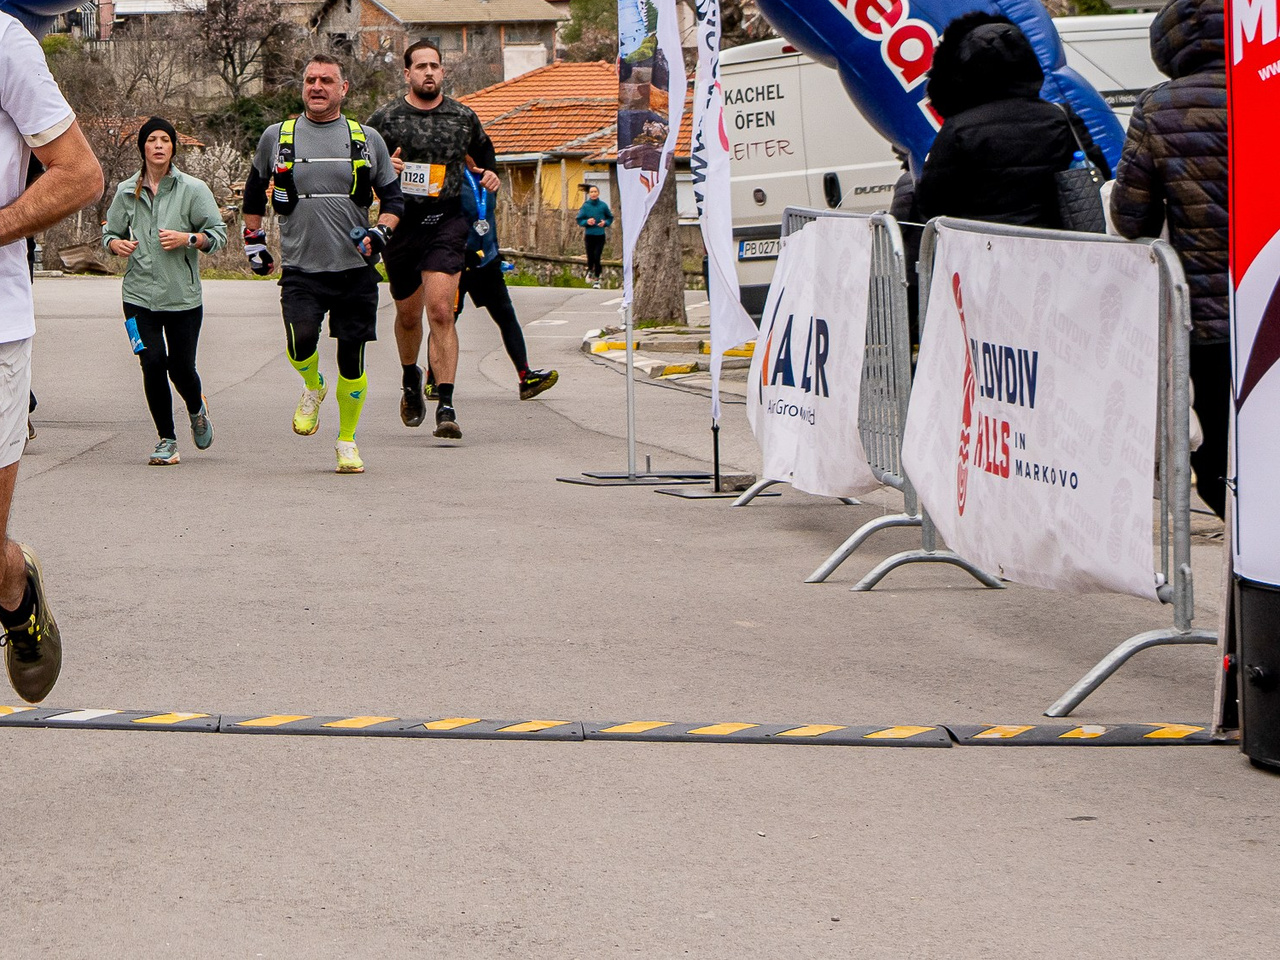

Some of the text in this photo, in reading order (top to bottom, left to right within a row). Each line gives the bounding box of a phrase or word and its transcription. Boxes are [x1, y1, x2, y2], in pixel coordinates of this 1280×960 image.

[724, 83, 785, 106] KACHEL
[735, 110, 776, 130] ÖFEN
[729, 139, 794, 161] EITER
[404, 171, 425, 184] 1128
[854, 184, 895, 196] DUCAT
[1014, 431, 1026, 450] IN
[1015, 459, 1078, 490] MARKOVO
